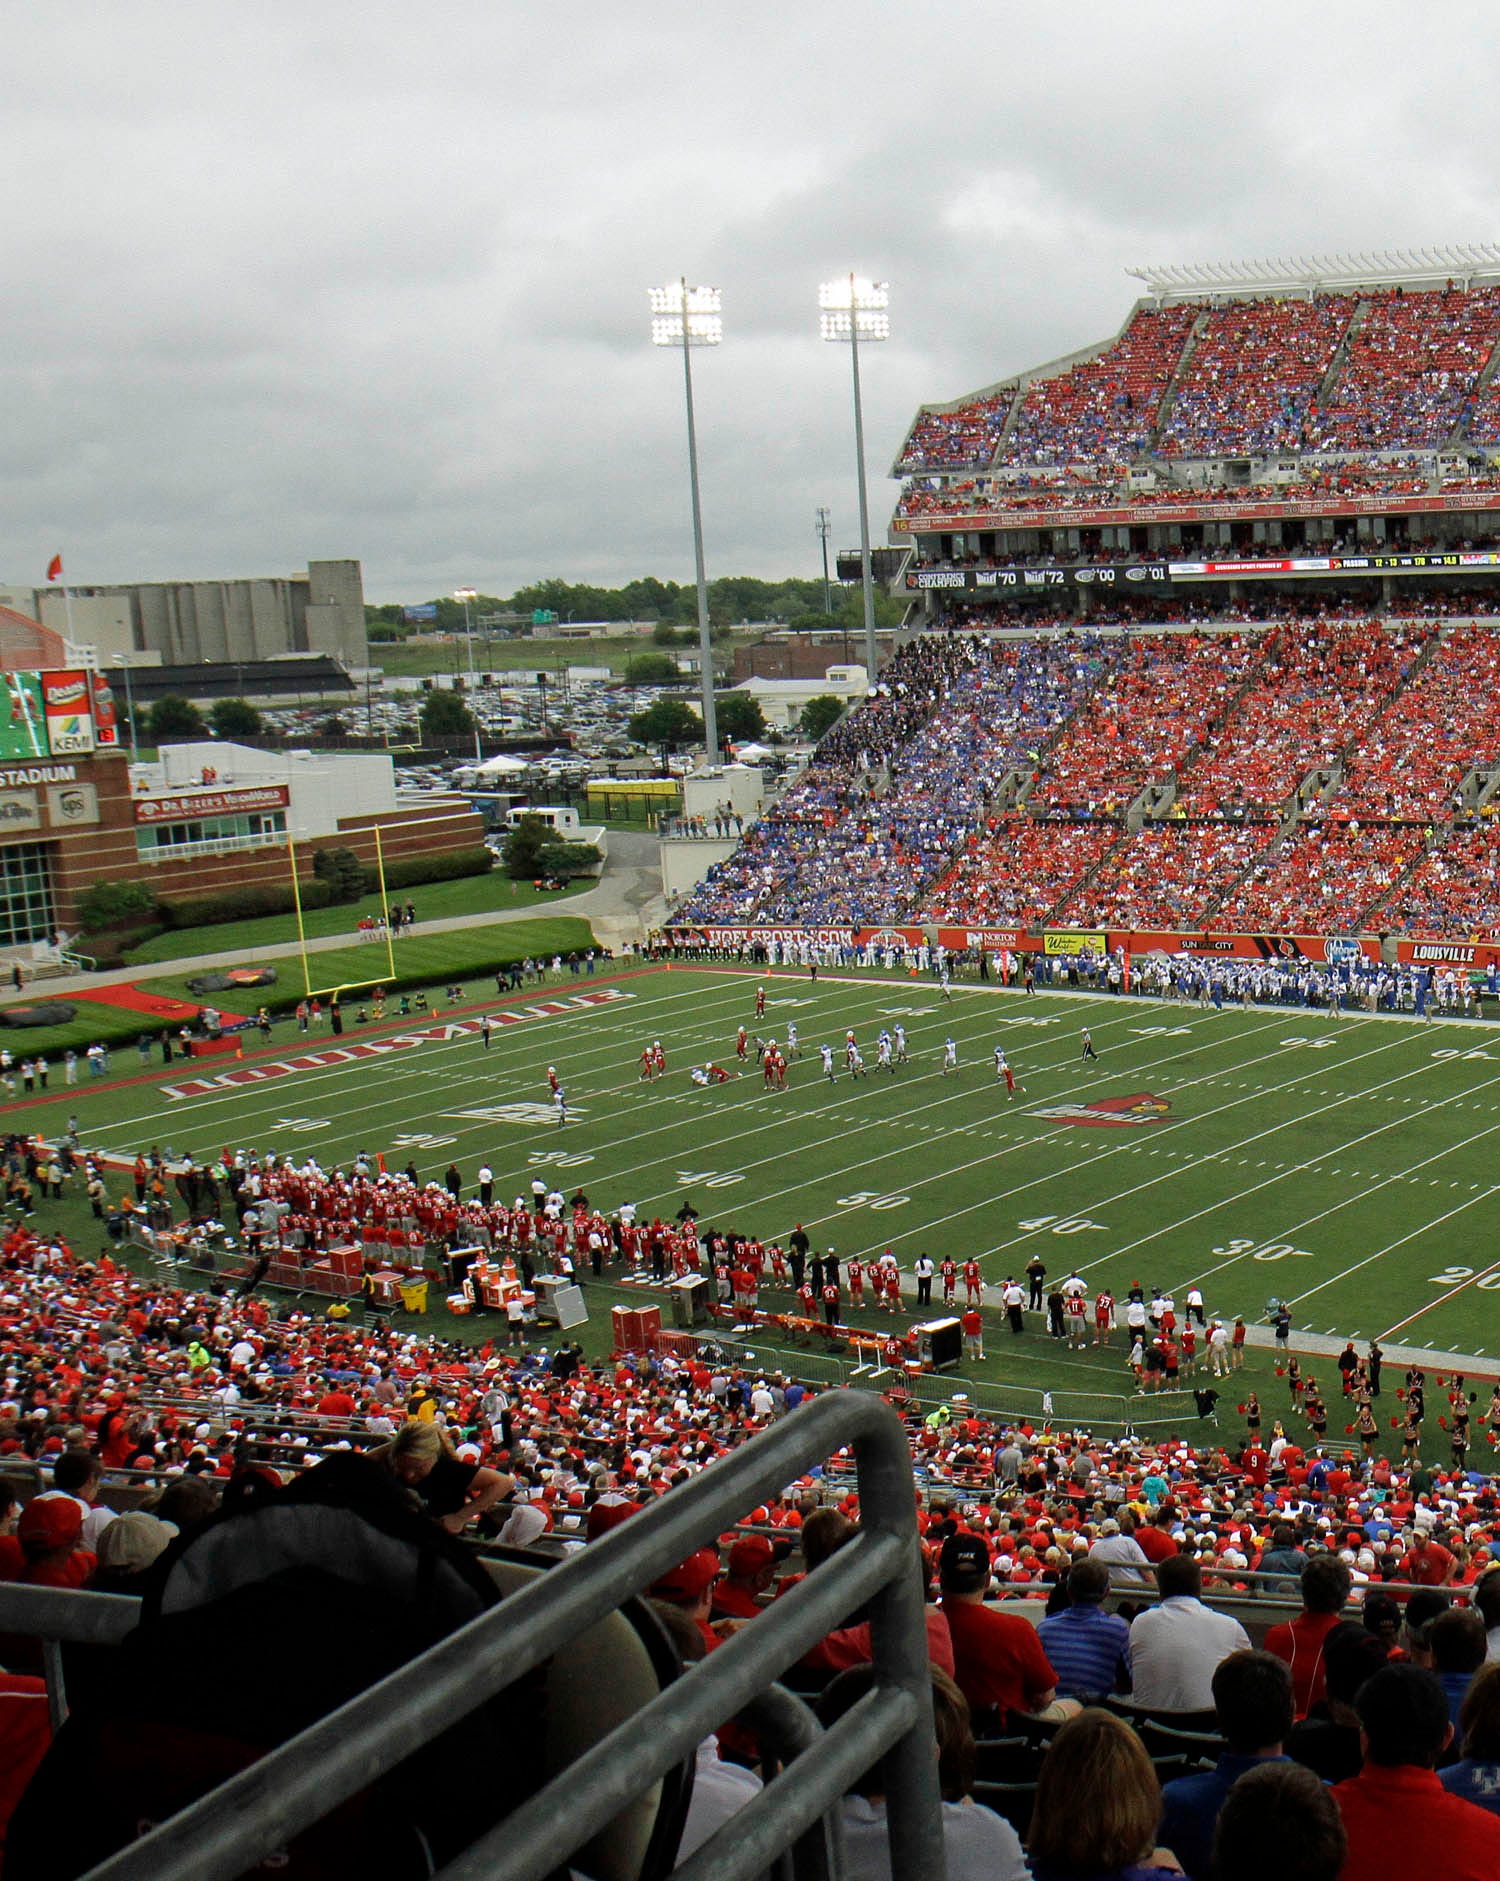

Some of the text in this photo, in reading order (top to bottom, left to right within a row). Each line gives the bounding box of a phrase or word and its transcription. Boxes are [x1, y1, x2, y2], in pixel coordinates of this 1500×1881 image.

[1343, 559, 1369, 567] PASSING
[918, 580, 965, 588] CHAMPION
[0, 765, 76, 787] STADIUM
[983, 932, 1017, 941] NORTON
[1181, 941, 1197, 949] SUN
[1215, 942, 1233, 950] CITY
[1412, 945, 1475, 962] LOUISVILLE
[158, 988, 637, 1102] LOUISVILLE
[836, 1190, 911, 1210] 50
[1017, 1214, 1095, 1236] 40
[1211, 1238, 1297, 1262] 30
[1251, 1454, 1258, 1468] 9
